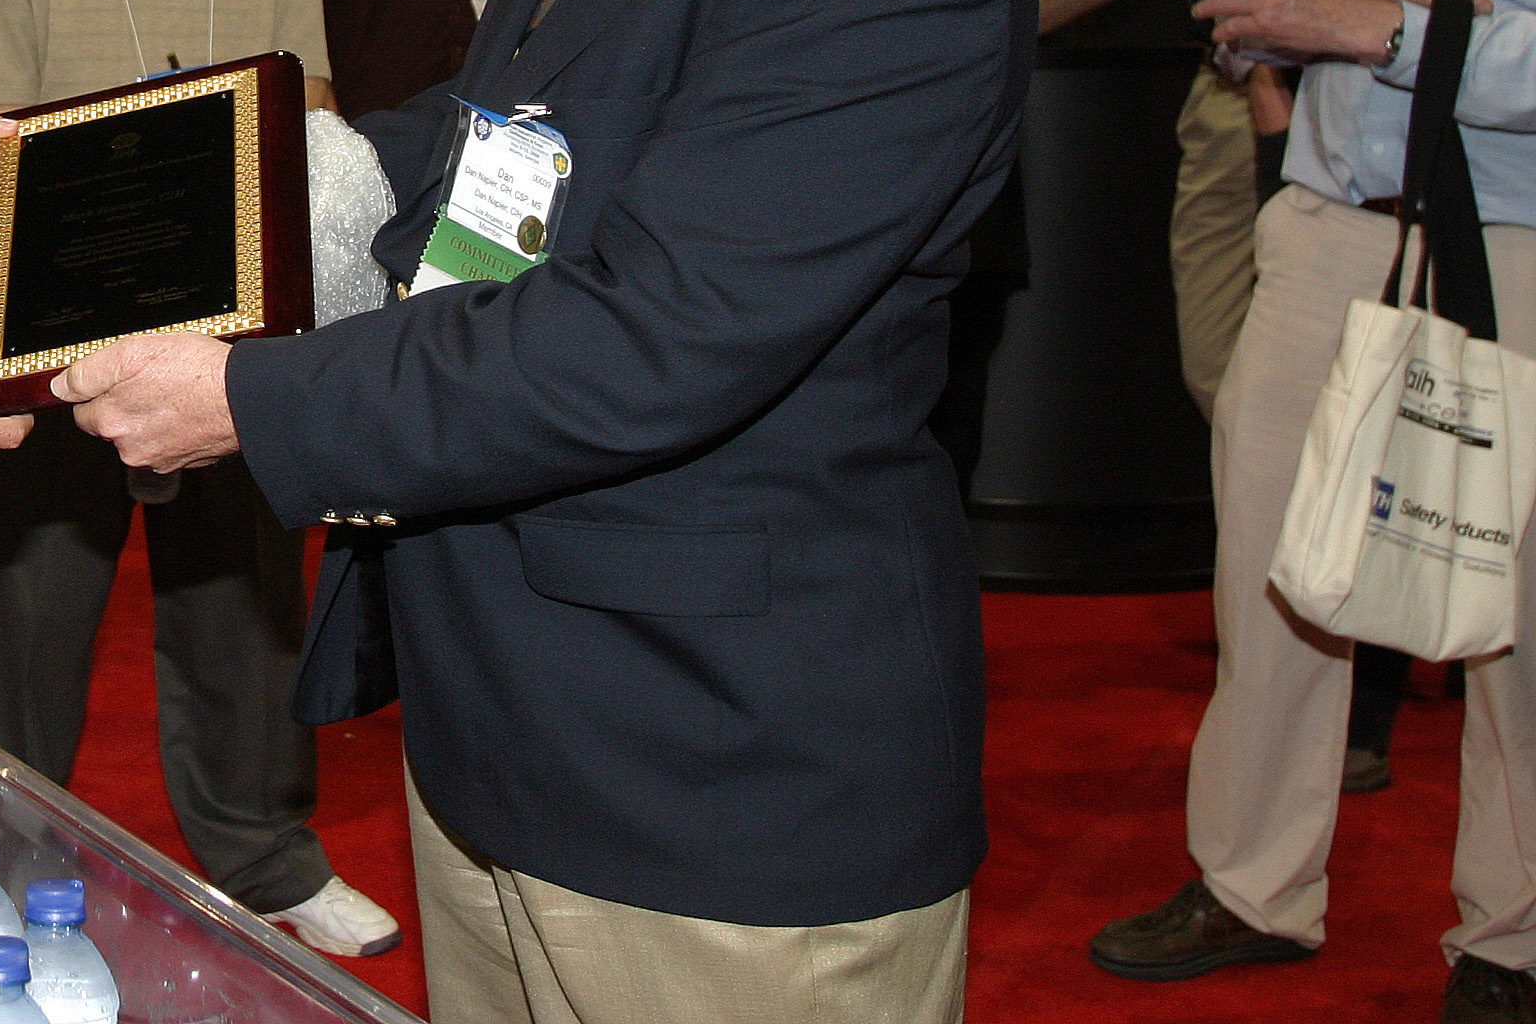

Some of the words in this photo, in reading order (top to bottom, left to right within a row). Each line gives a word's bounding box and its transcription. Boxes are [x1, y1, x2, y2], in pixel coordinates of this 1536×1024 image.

[464, 165, 478, 178] Dan
[497, 168, 515, 184] Dan
[474, 188, 488, 202] Dan
[1400, 497, 1448, 529] Safety
